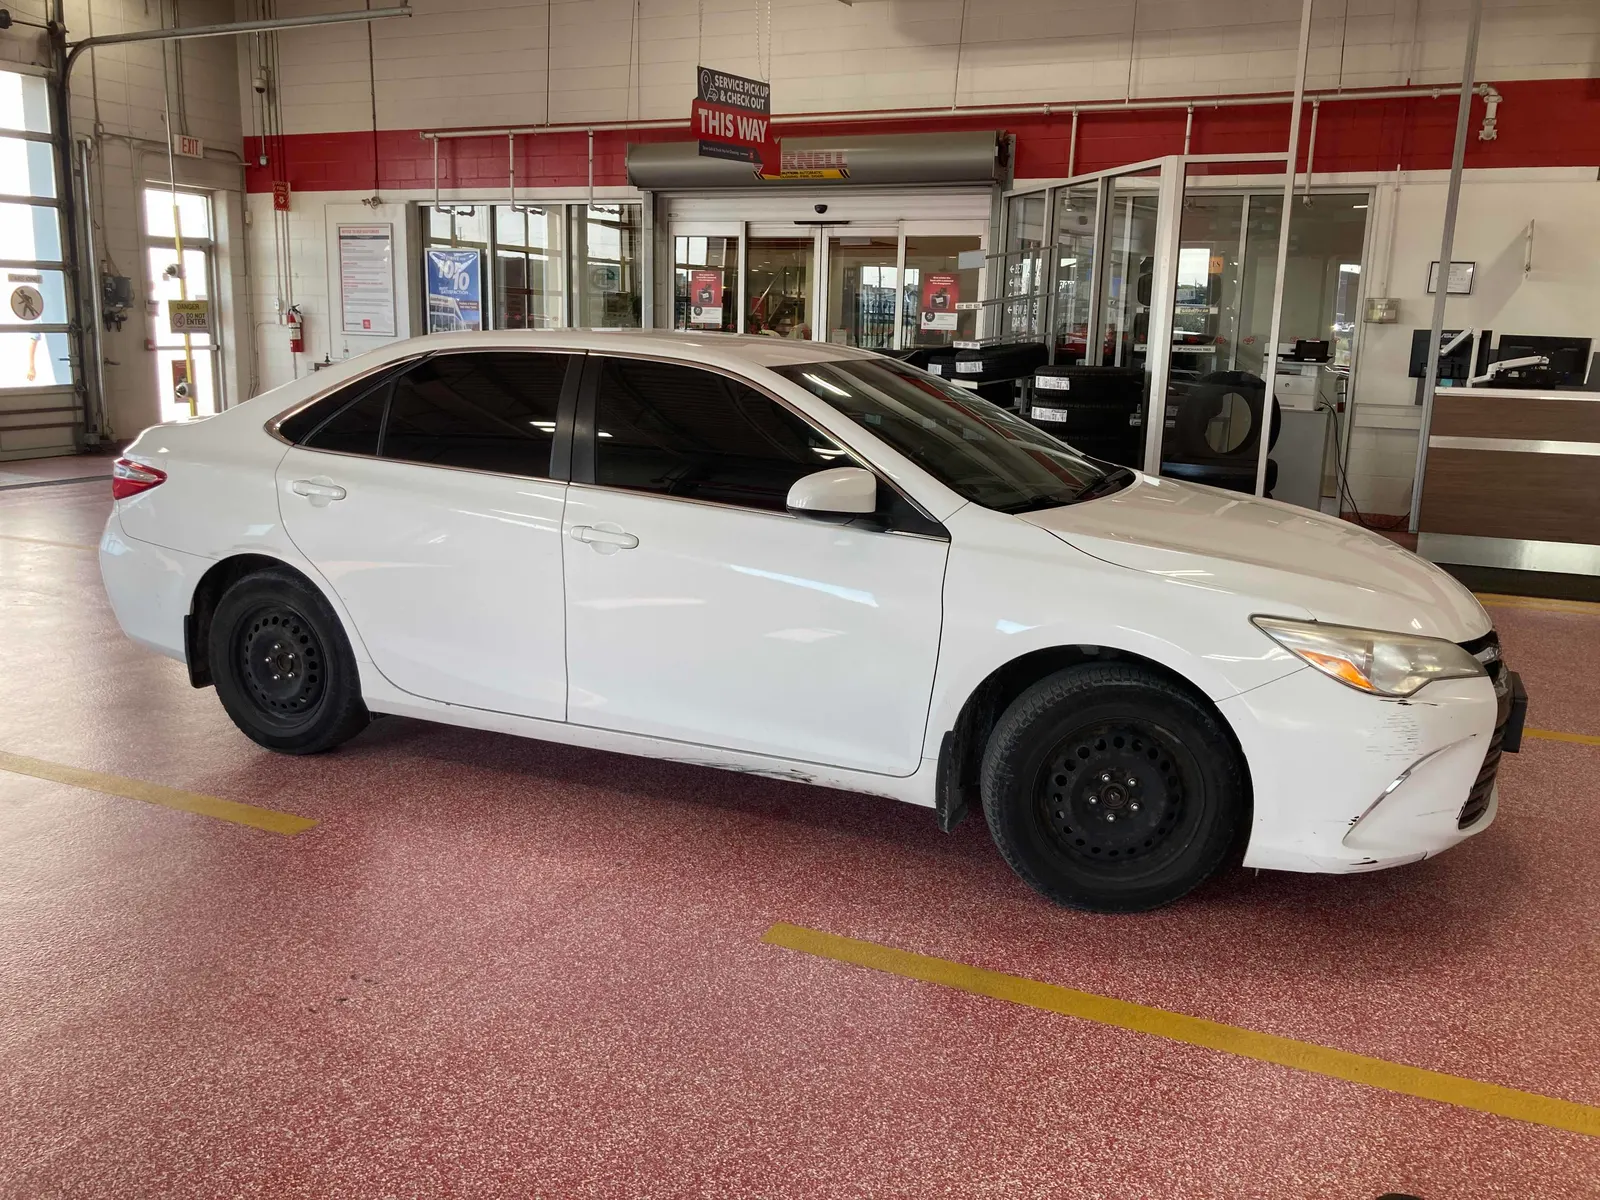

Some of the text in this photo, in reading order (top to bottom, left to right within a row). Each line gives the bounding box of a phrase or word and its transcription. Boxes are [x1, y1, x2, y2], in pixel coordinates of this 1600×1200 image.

[714, 75, 769, 98] SERVICE PICK UP
[719, 90, 765, 110] & CHECK OUT
[698, 108, 768, 143] THIS WAY
[182, 137, 199, 155] EXIT
[453, 272, 470, 291] 10
[186, 318, 206, 326] ENTER
